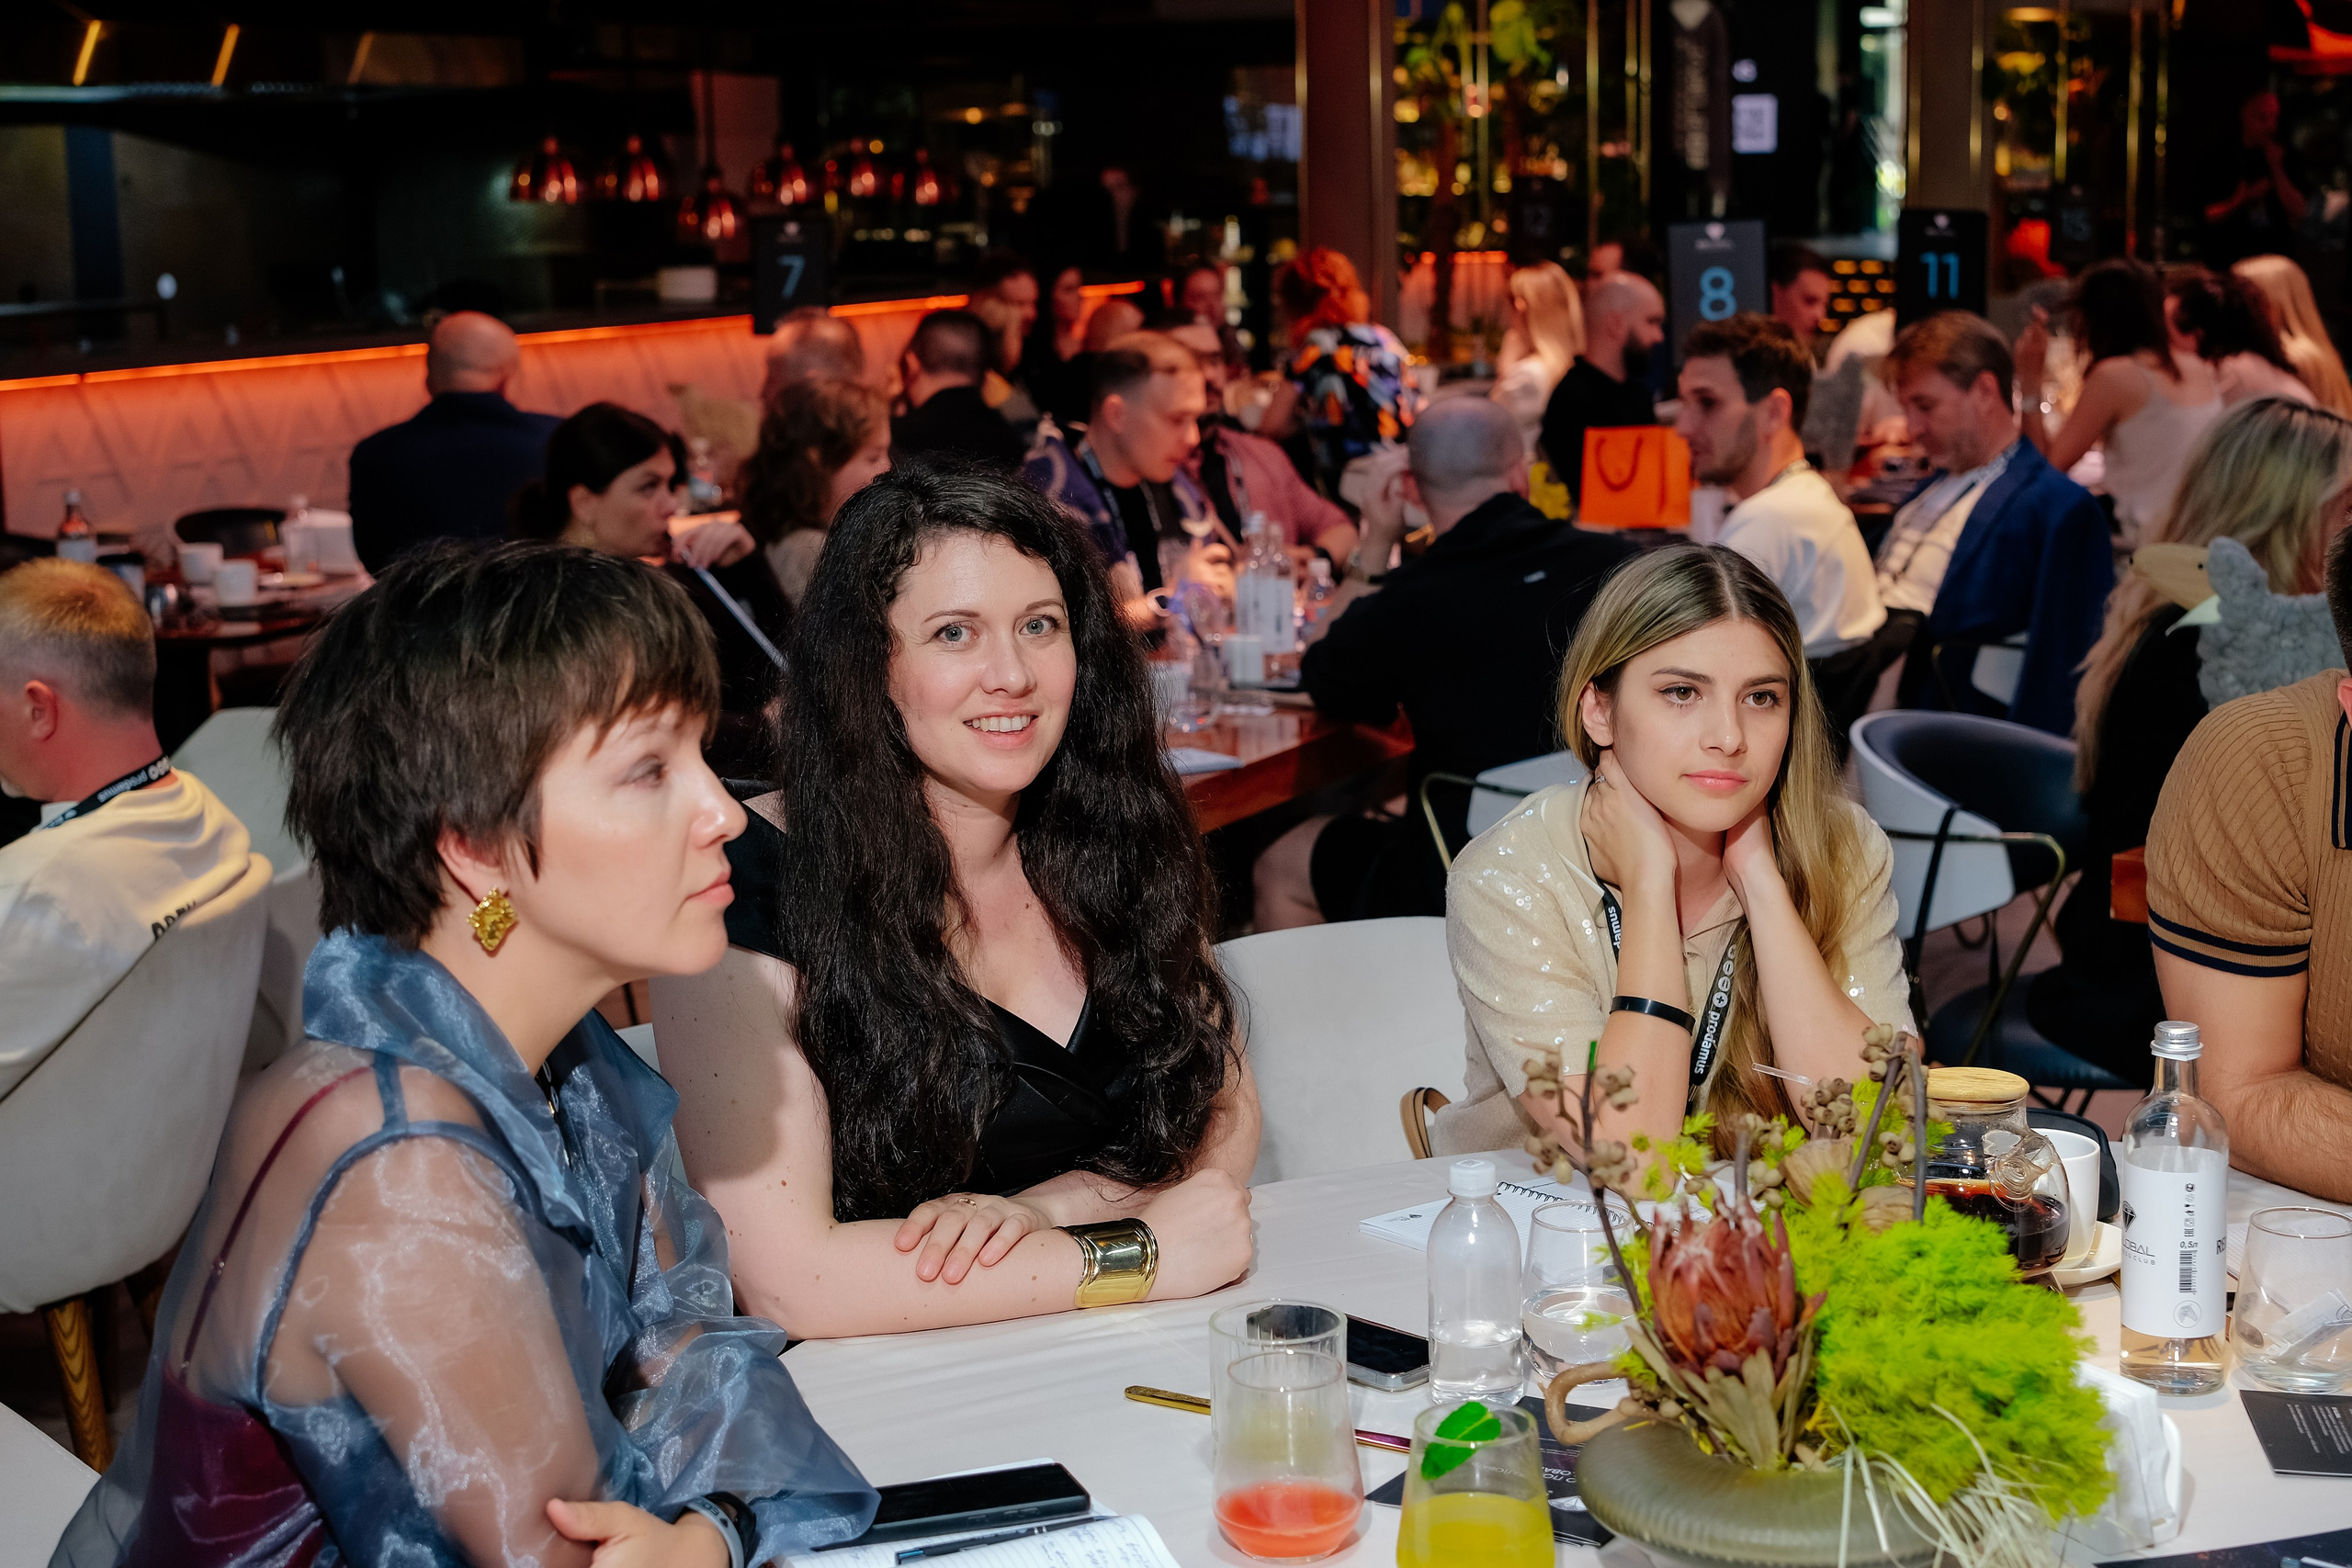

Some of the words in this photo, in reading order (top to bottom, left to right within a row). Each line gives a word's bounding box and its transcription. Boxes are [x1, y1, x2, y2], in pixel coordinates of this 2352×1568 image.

[778, 254, 806, 299] 7
[1700, 265, 1736, 321] 8
[1920, 252, 1960, 299] 11
[1694, 1010, 1720, 1075] prodamus
[2122, 1238, 2155, 1258] OBAL
